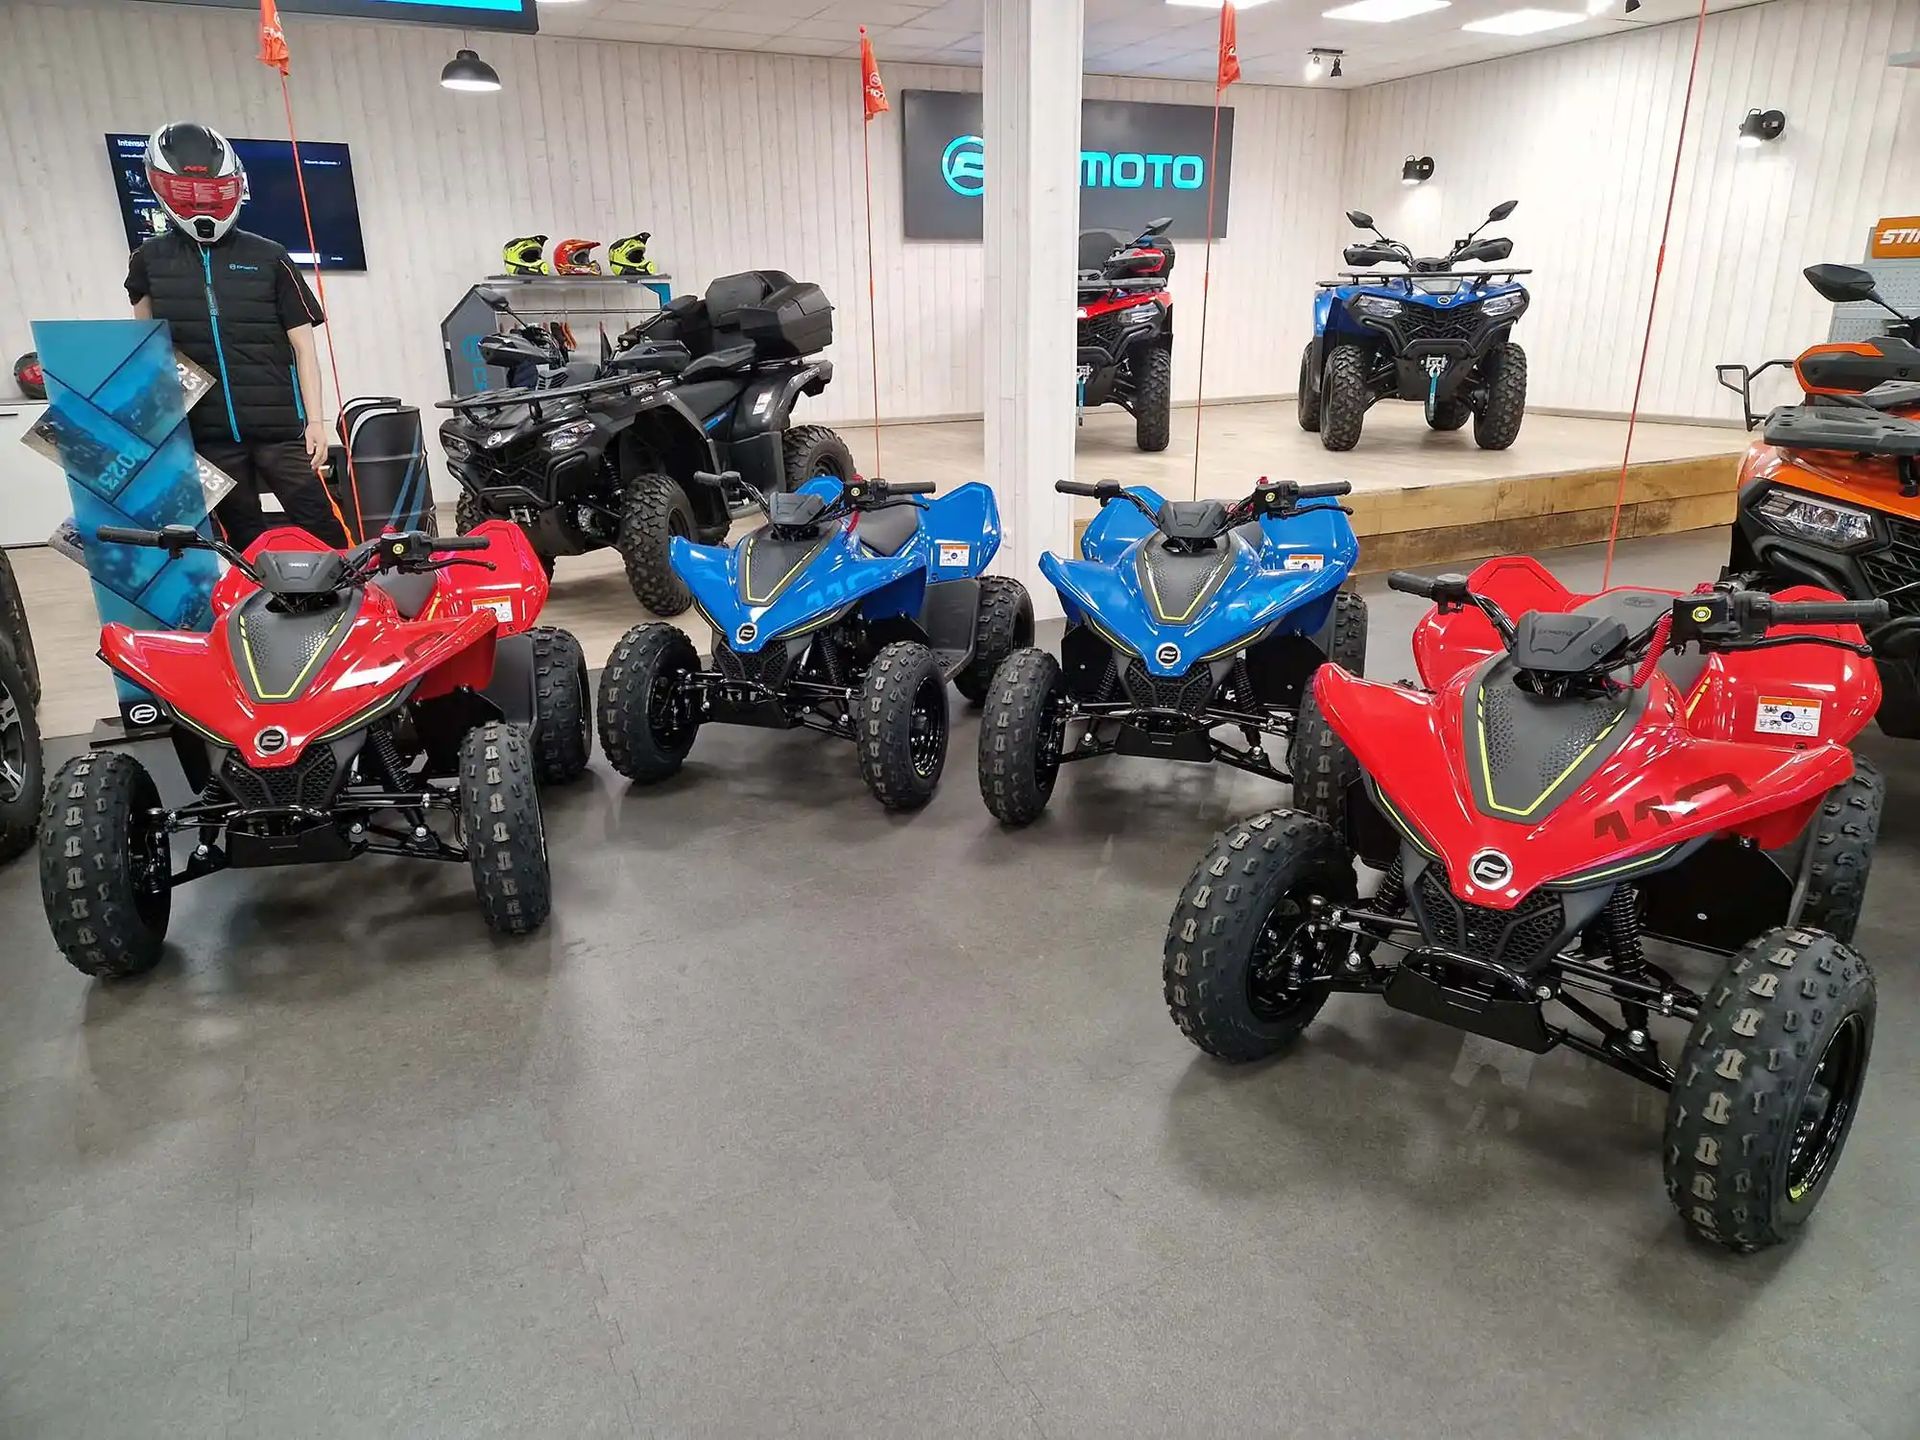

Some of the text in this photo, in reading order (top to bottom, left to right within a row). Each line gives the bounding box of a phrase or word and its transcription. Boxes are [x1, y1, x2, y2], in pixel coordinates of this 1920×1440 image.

[117, 138, 146, 148] Intenso
[1080, 151, 1205, 190] MOTO
[176, 363, 202, 391] 23
[198, 463, 225, 491] 23
